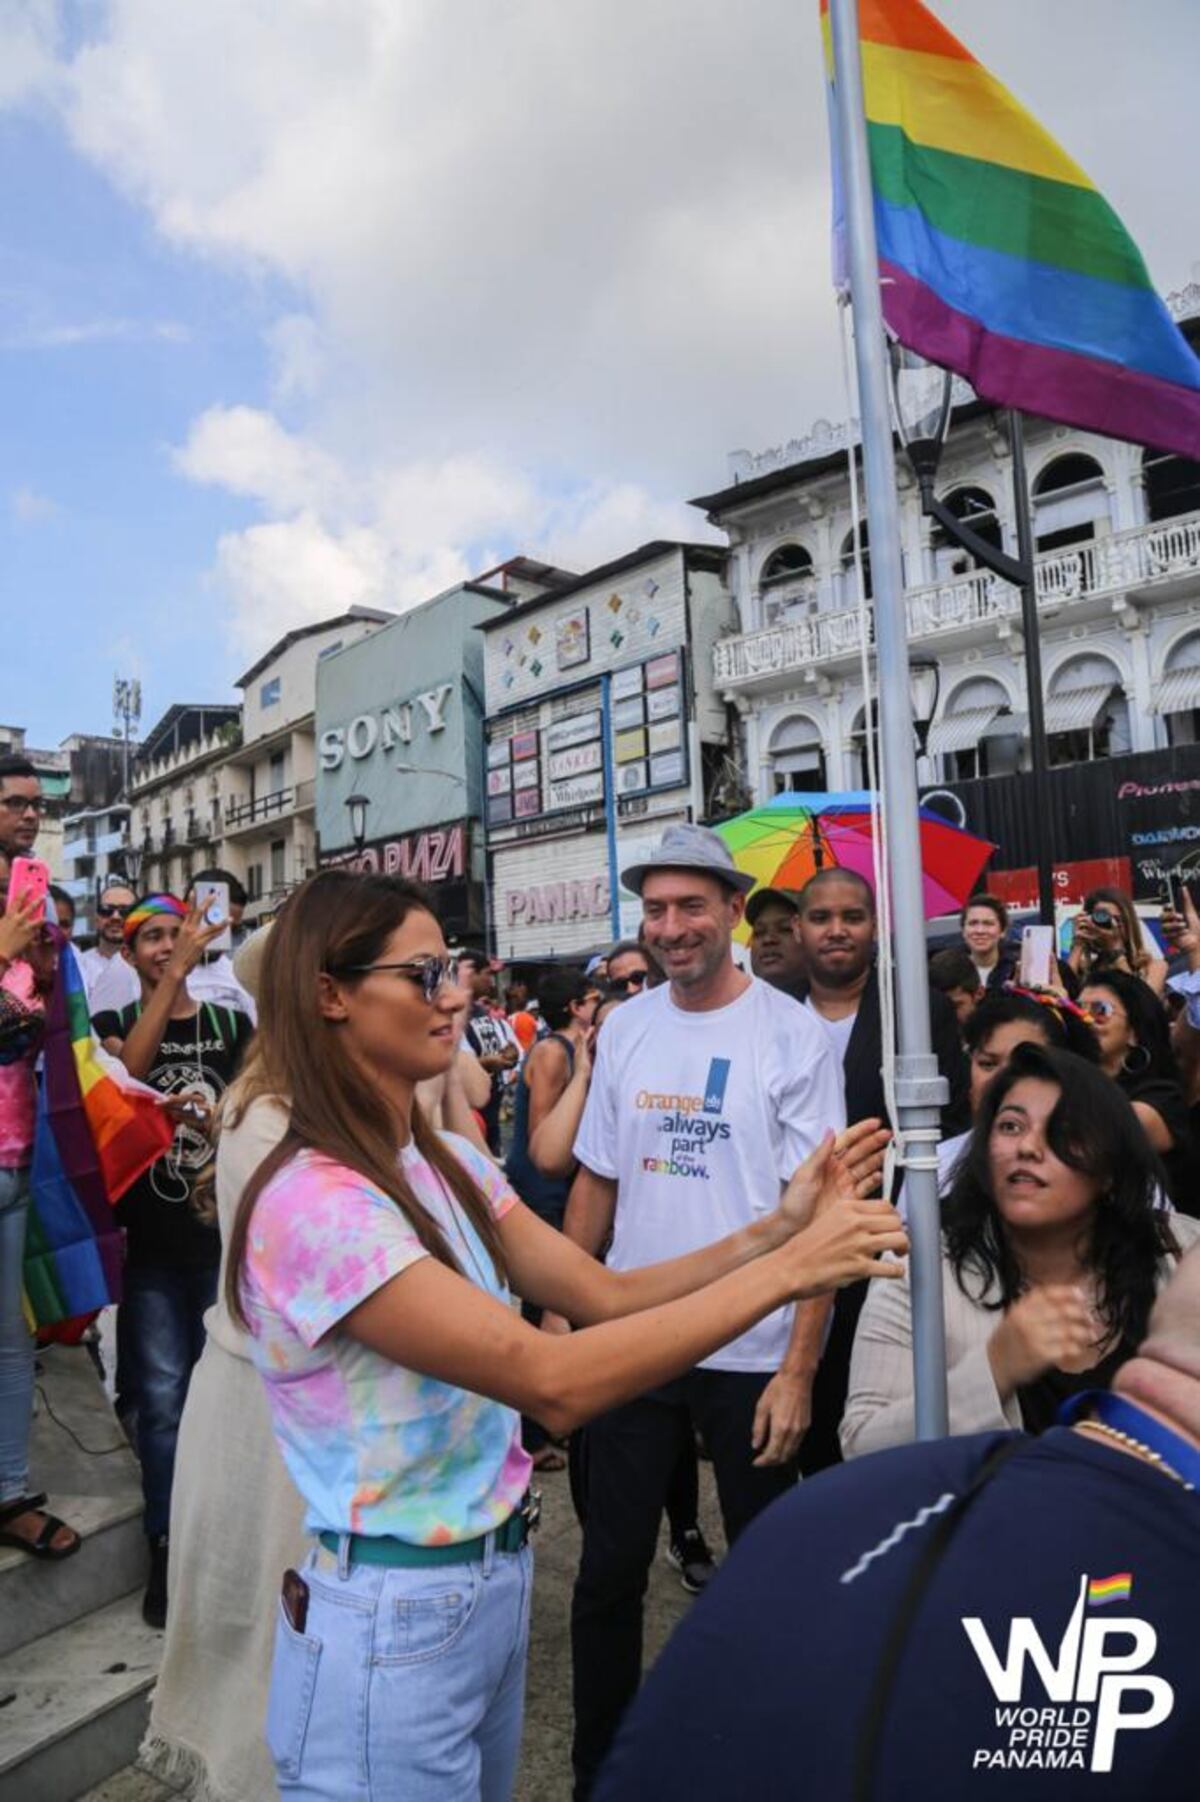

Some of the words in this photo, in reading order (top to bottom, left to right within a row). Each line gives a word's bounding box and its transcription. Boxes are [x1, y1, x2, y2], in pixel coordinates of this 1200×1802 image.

[319, 684, 453, 771] SONY
[384, 827, 464, 881] PLAZA
[635, 1090, 704, 1116] Orange
[671, 1137, 706, 1155] part
